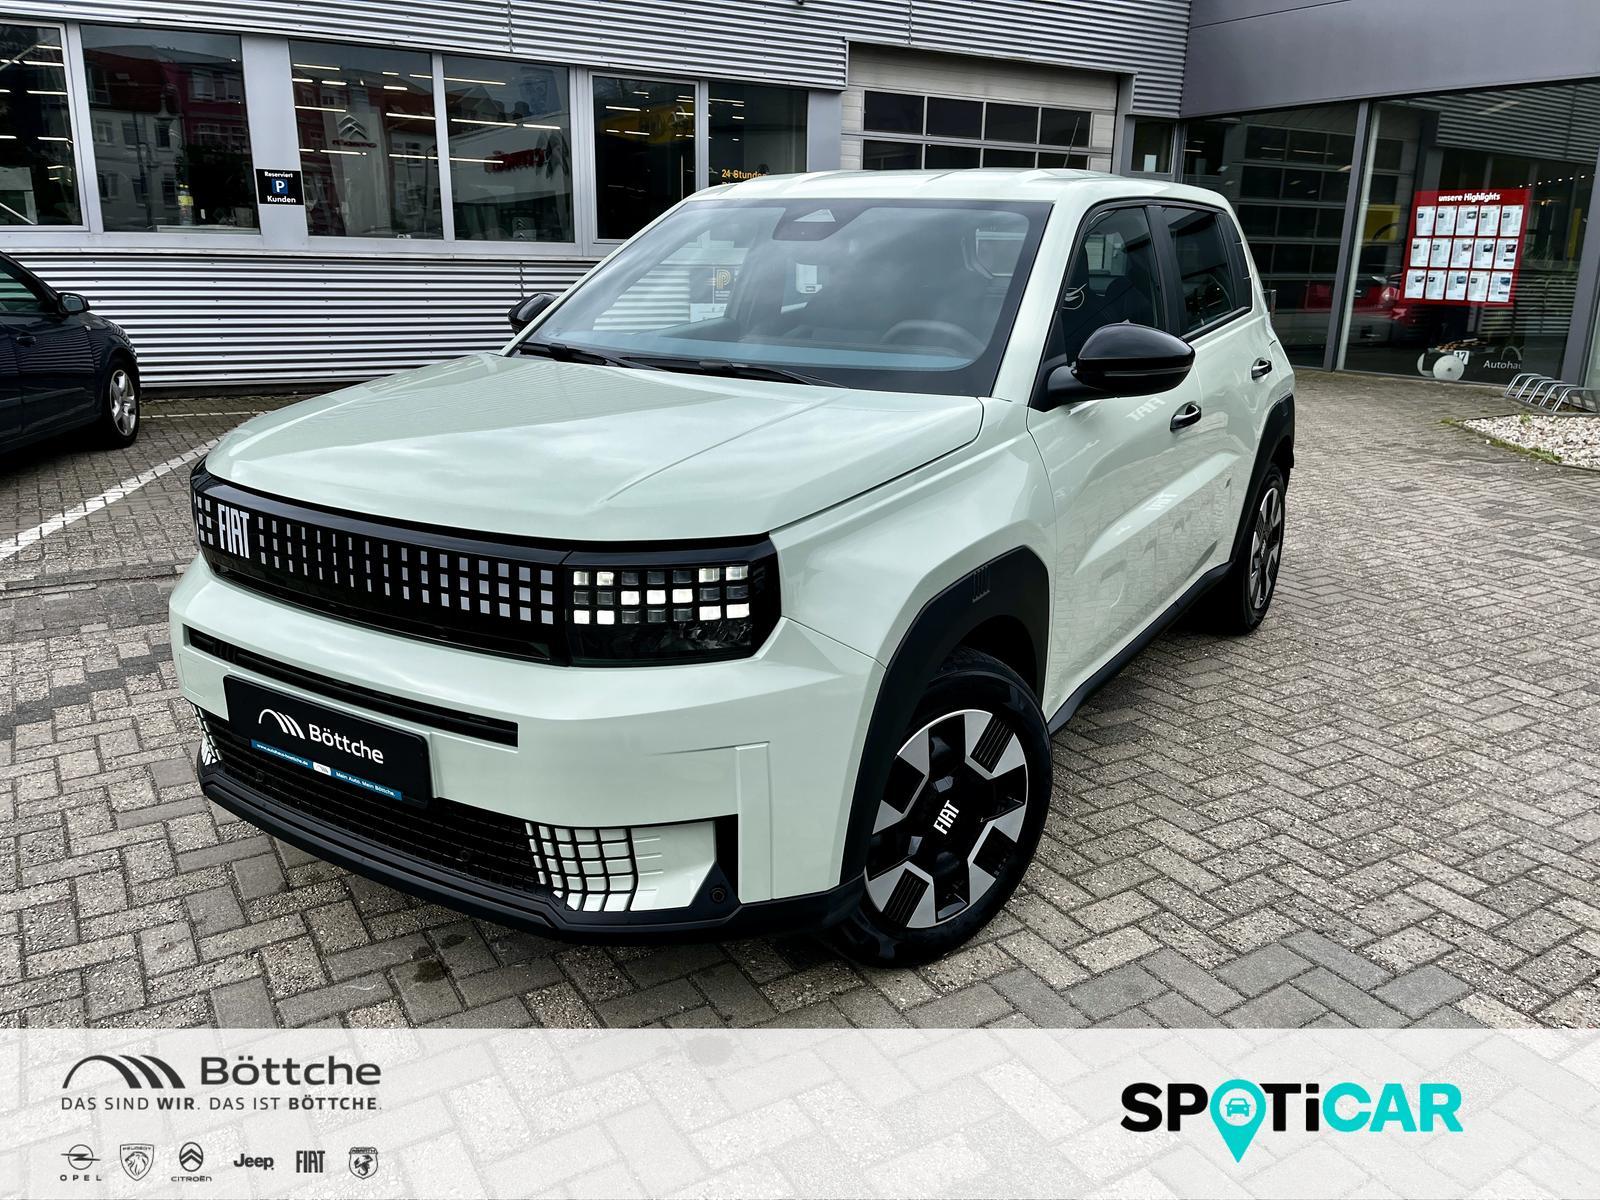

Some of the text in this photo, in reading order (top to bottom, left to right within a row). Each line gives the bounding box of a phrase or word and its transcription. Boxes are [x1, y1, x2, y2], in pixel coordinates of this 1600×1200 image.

[275, 180, 285, 193] P
[1463, 192, 1501, 203] Highlights
[267, 195, 296, 203] Kunden
[217, 503, 250, 559] FIAT
[308, 723, 384, 765] Böttche
[933, 800, 960, 835] FIAT
